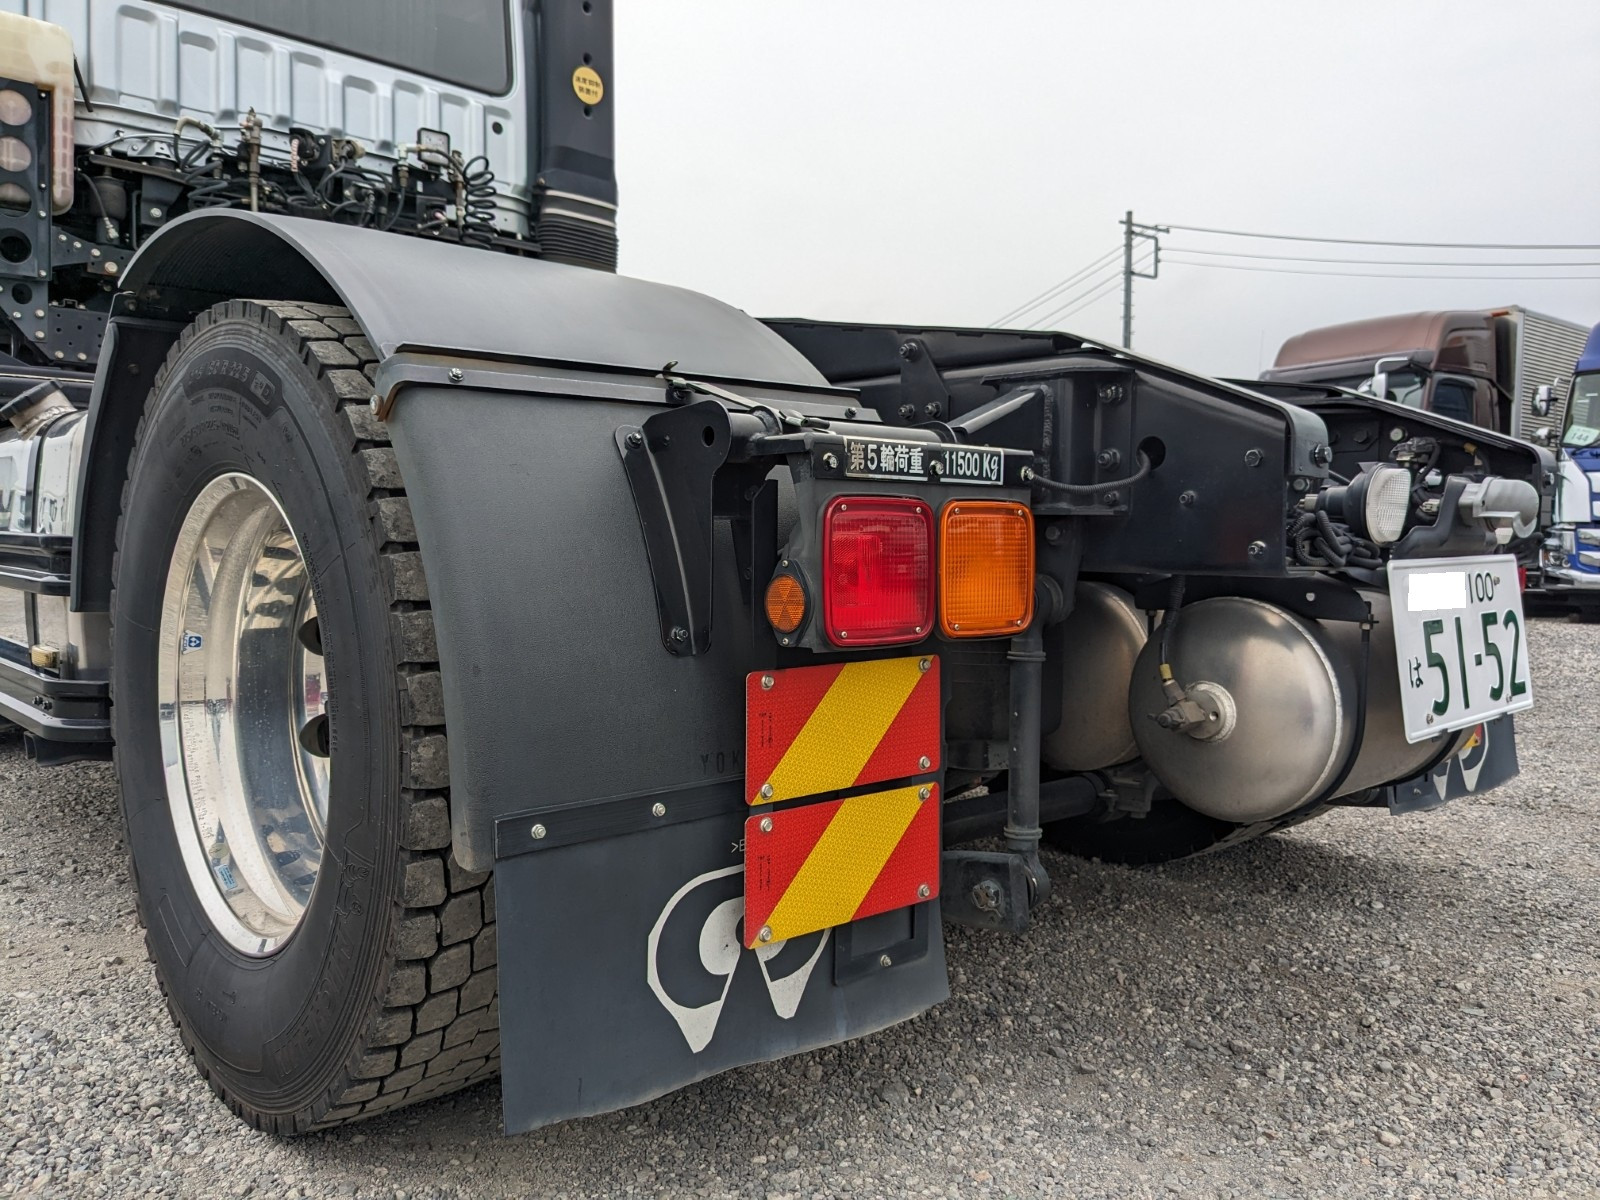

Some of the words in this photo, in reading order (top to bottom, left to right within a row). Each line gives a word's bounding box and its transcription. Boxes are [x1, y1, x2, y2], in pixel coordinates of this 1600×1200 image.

[1571, 432, 1589, 442] 144
[849, 441, 924, 475] 第5輪荷重
[944, 451, 980, 476] 11500
[982, 452, 999, 480] Kg
[1468, 572, 1494, 603] 100
[1408, 657, 1424, 689] は
[1422, 609, 1527, 716] 51-52
